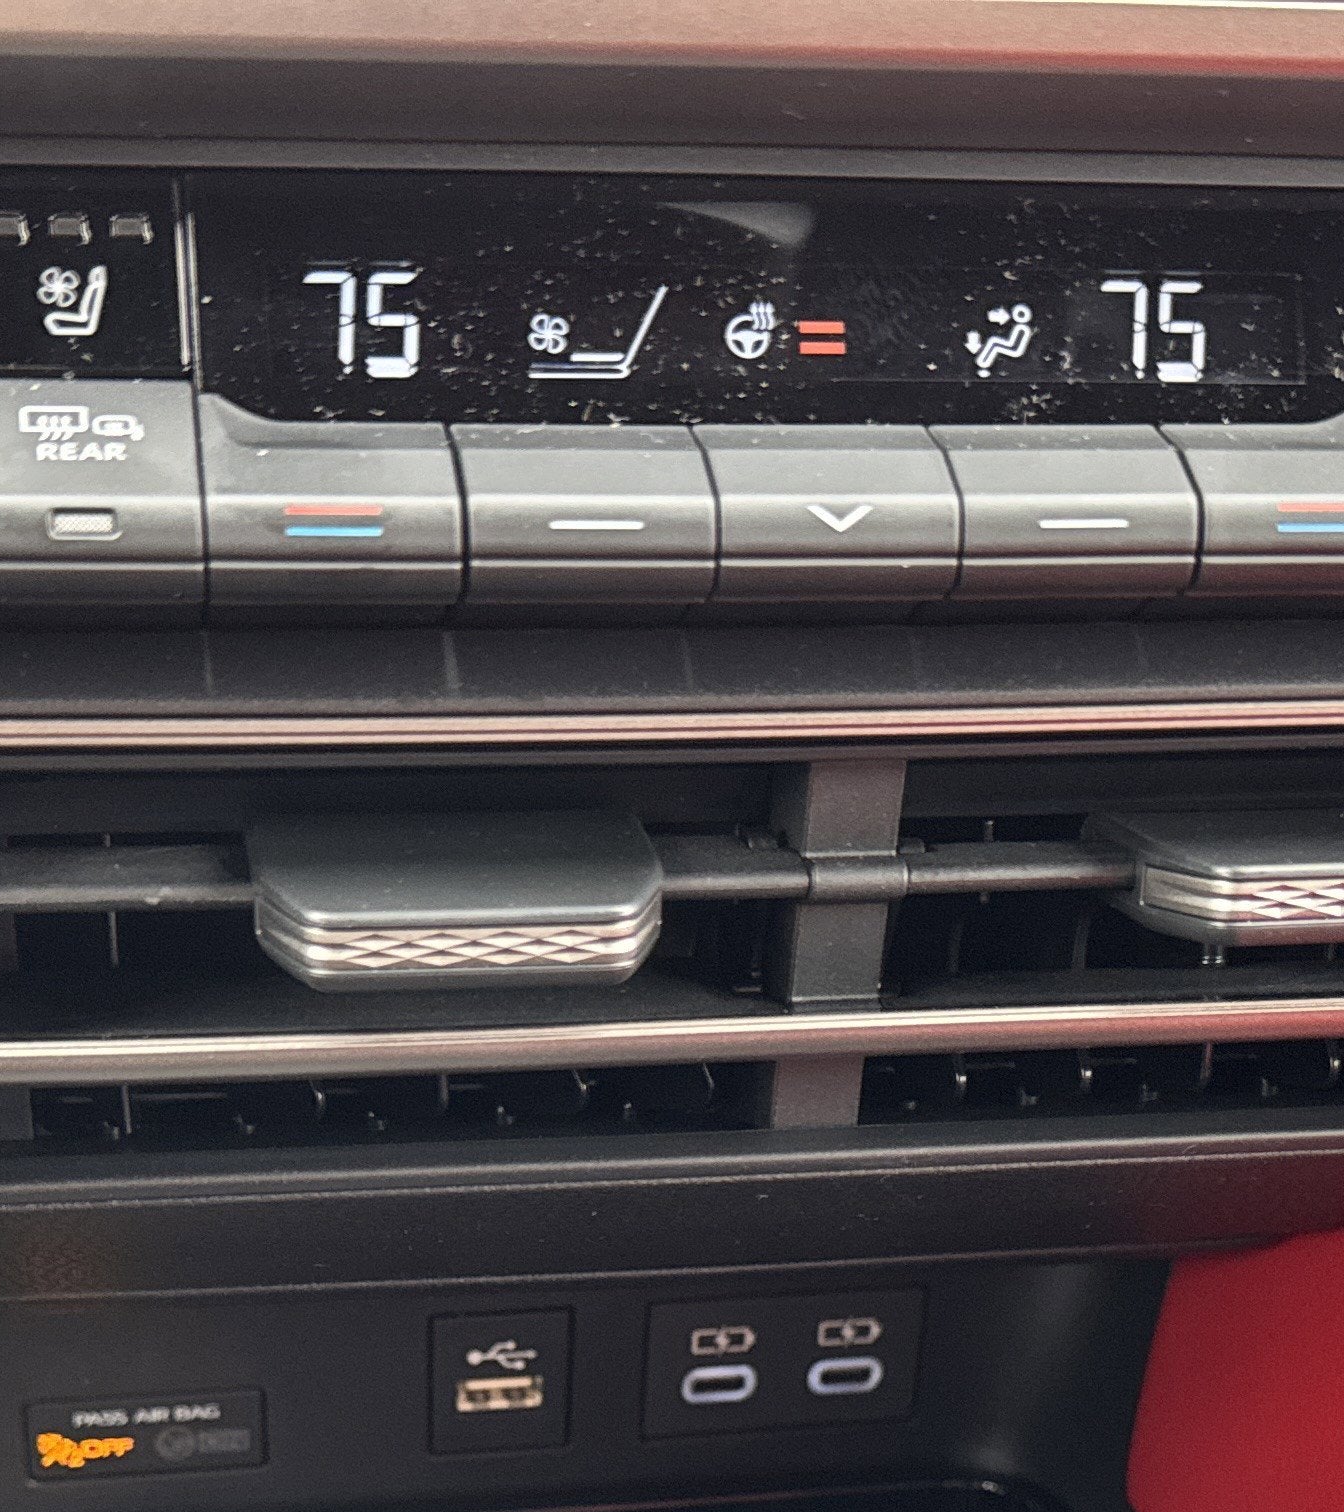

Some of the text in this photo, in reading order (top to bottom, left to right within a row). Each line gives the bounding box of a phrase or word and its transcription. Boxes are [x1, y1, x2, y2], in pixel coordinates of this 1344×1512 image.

[302, 270, 420, 378] 75
[1099, 279, 1205, 383] 75
[35, 441, 129, 463] REAR
[70, 1402, 222, 1429] PASS AIR BAG
[79, 1436, 135, 1460] OFF
